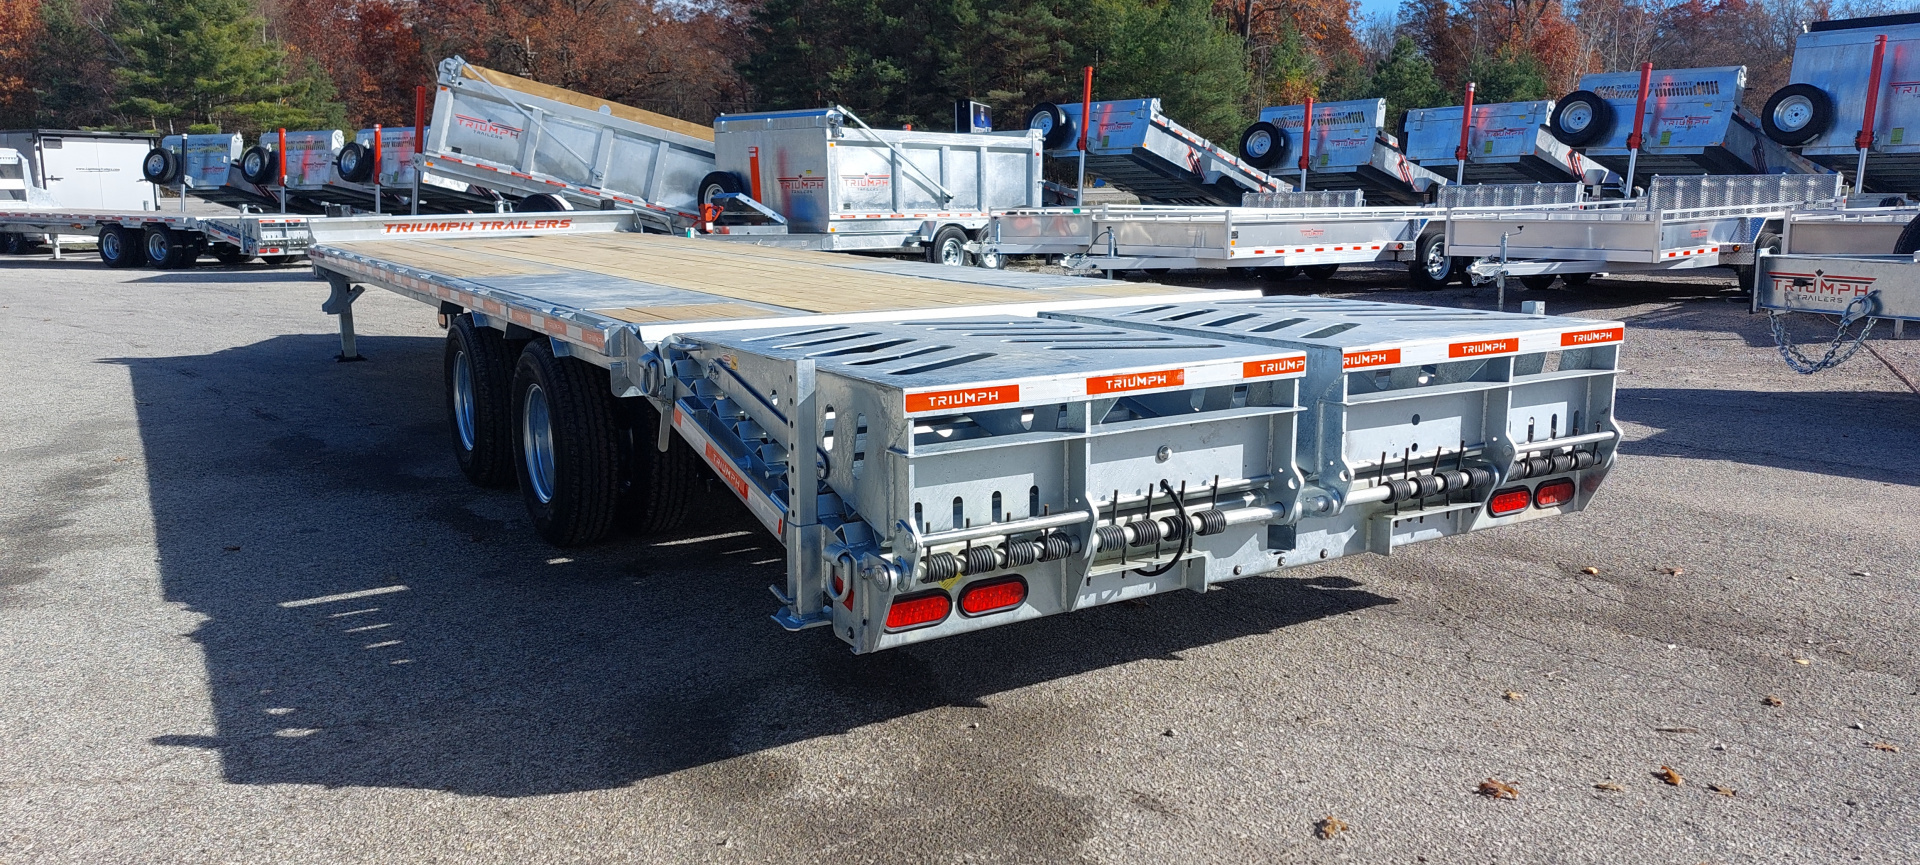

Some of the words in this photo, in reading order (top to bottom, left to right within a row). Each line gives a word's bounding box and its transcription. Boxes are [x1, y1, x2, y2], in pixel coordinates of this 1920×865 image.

[458, 119, 519, 139] TRIUMPH
[473, 130, 503, 139] TRAILERS
[781, 181, 824, 189] TRIUMPH
[845, 179, 889, 187] TRIUMPH
[384, 221, 474, 233] TRIUMPH
[479, 219, 572, 231] TRAILERS
[1773, 279, 1869, 297] TRIUMPH
[1797, 294, 1843, 304] TRAILERS
[1573, 332, 1613, 343] TRIUMPH
[1463, 342, 1506, 354] TRIUMPH
[1260, 359, 1305, 373] TRIUMP
[1106, 375, 1167, 390] TRIUMPH
[928, 390, 999, 406] TRIUMPH
[713, 453, 740, 488] TRIUMPH
